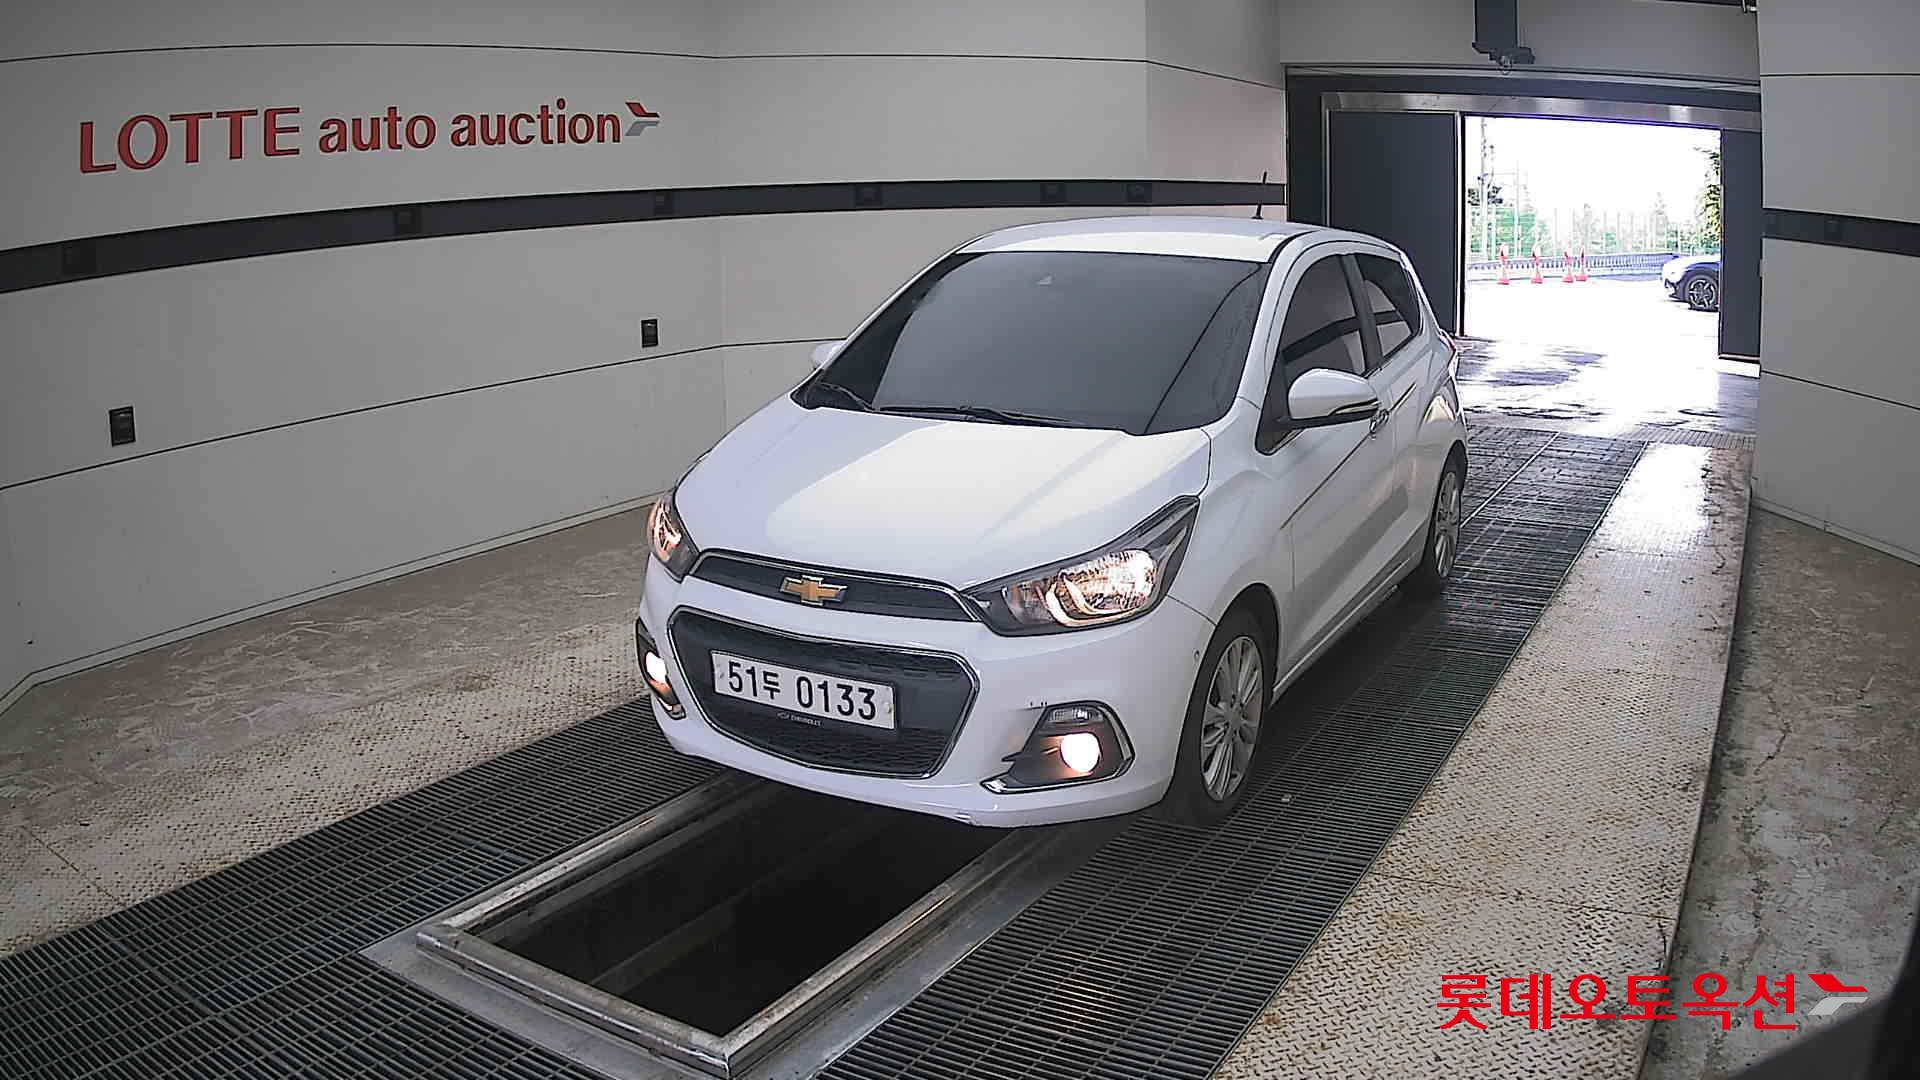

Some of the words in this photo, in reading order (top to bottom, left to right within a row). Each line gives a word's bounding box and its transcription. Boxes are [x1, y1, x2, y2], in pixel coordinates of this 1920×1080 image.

[80, 106, 300, 174] LOTTE
[318, 105, 437, 154] auto
[450, 98, 622, 148] auction
[728, 661, 781, 700] 51두
[796, 676, 876, 721] 0133
